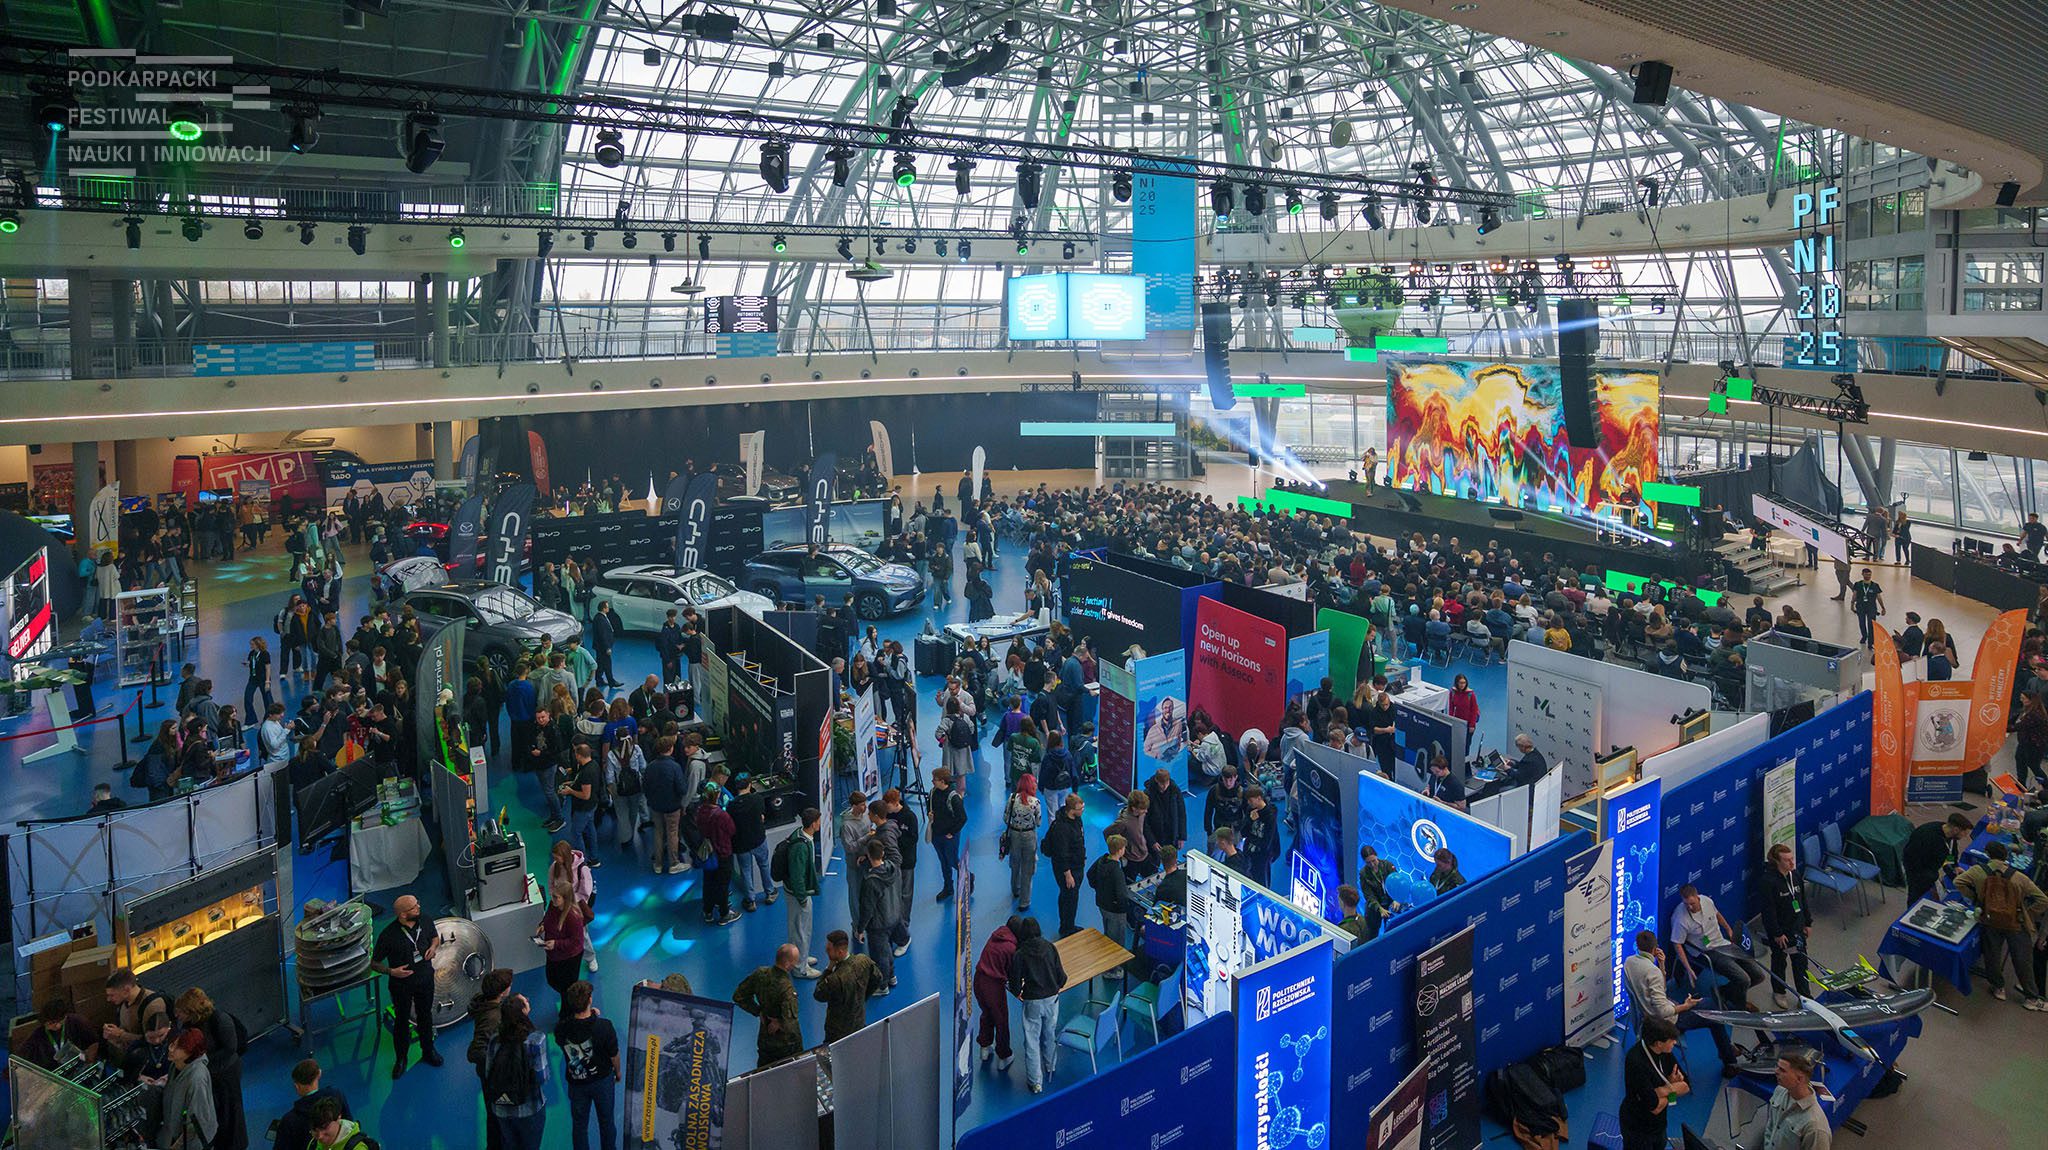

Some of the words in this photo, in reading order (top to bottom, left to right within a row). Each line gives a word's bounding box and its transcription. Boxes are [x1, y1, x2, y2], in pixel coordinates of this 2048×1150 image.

[1140, 178, 1154, 188] NI
[1140, 191, 1155, 201] 20
[1140, 205, 1155, 215] 25
[1793, 187, 1840, 229] PF
[1794, 236, 1835, 273] NI
[1797, 284, 1842, 319] 20
[1797, 331, 1841, 366] 25
[217, 458, 297, 493] TVP
[812, 479, 828, 544] BYD
[494, 512, 520, 586] BYD
[683, 499, 705, 569] BYD
[1107, 611, 1120, 621] gives
[1121, 615, 1144, 630] freedom
[1201, 624, 1226, 643] Open
[1227, 636, 1240, 649] up
[1200, 640, 1220, 655] new
[1221, 646, 1261, 672] horizons
[1200, 655, 1219, 669] with
[1741, 934, 1751, 950] 29
[1613, 938, 1624, 1004] Budujemy
[1272, 976, 1315, 1000] POLITECHNIKA
[1272, 986, 1311, 1009] RZESZOWSKA
[1426, 1026, 1438, 1037] Data
[1439, 1013, 1458, 1027] Science
[1441, 1042, 1462, 1060] Learning
[688, 1031, 705, 1109] ZASADNICZA
[698, 1083, 712, 1150] WOJSKOWA
